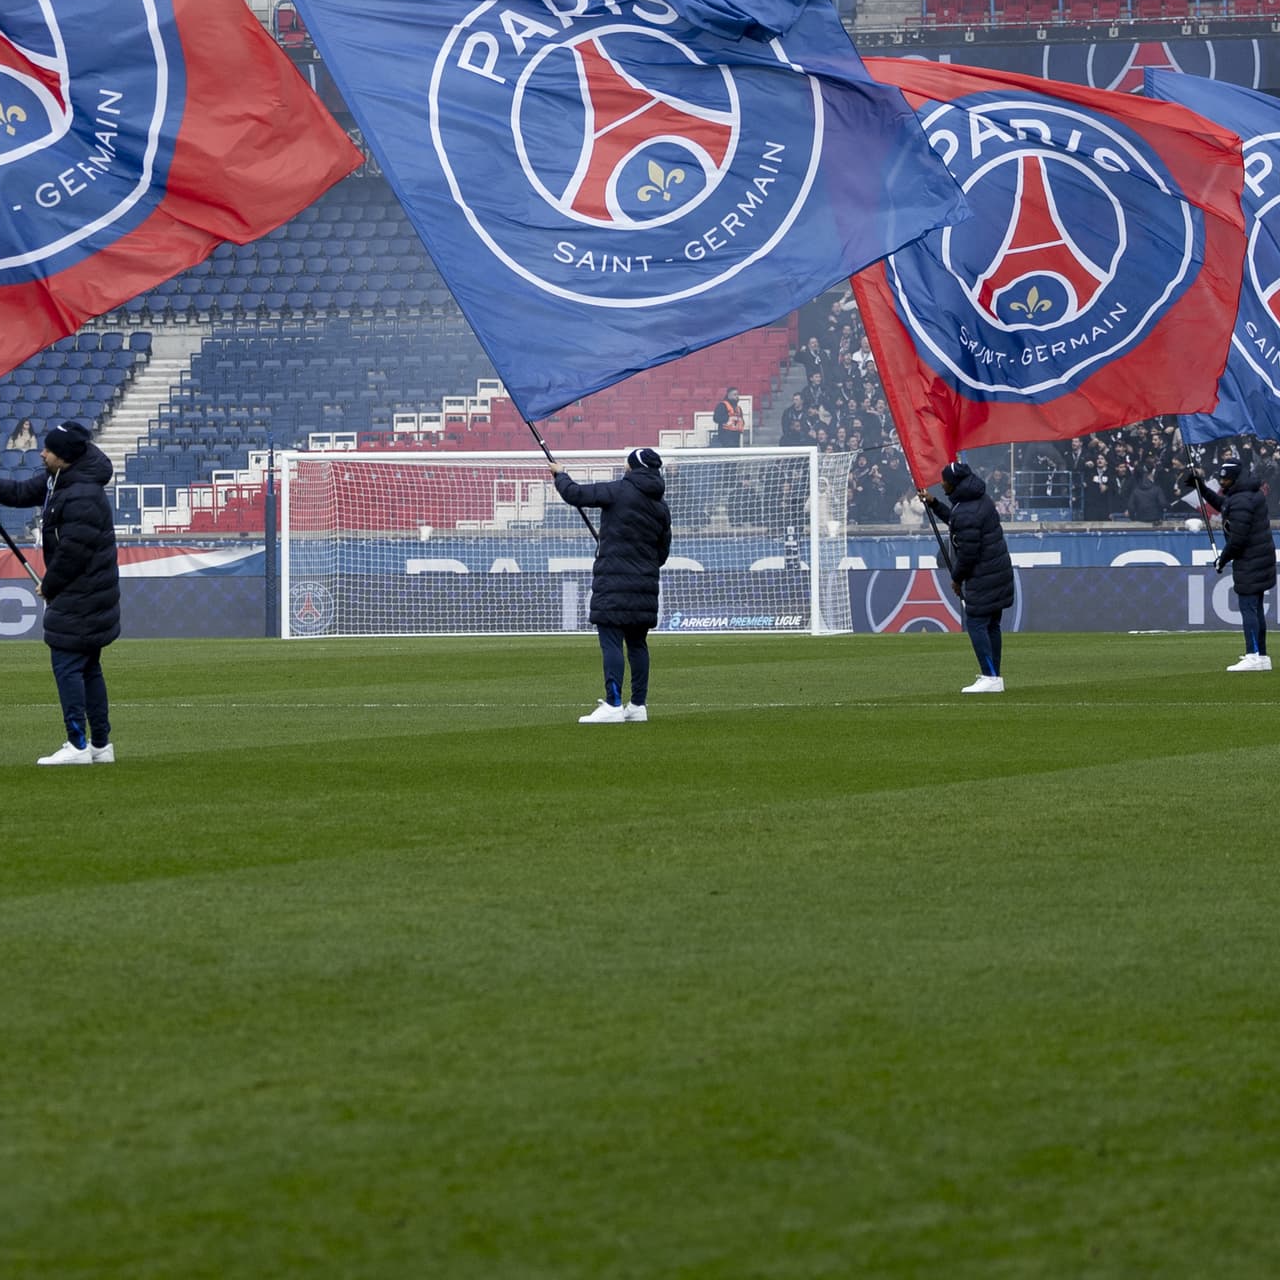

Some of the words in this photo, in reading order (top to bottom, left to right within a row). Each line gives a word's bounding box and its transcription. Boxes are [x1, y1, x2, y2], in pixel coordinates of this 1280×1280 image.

[35, 89, 123, 208] GERMAIN
[553, 241, 653, 273] SAINT
[684, 141, 786, 261] GERMAIN
[1021, 302, 1128, 366] GERMAIN
[680, 615, 729, 628] ARKEMA
[775, 615, 803, 626] LIGUE
